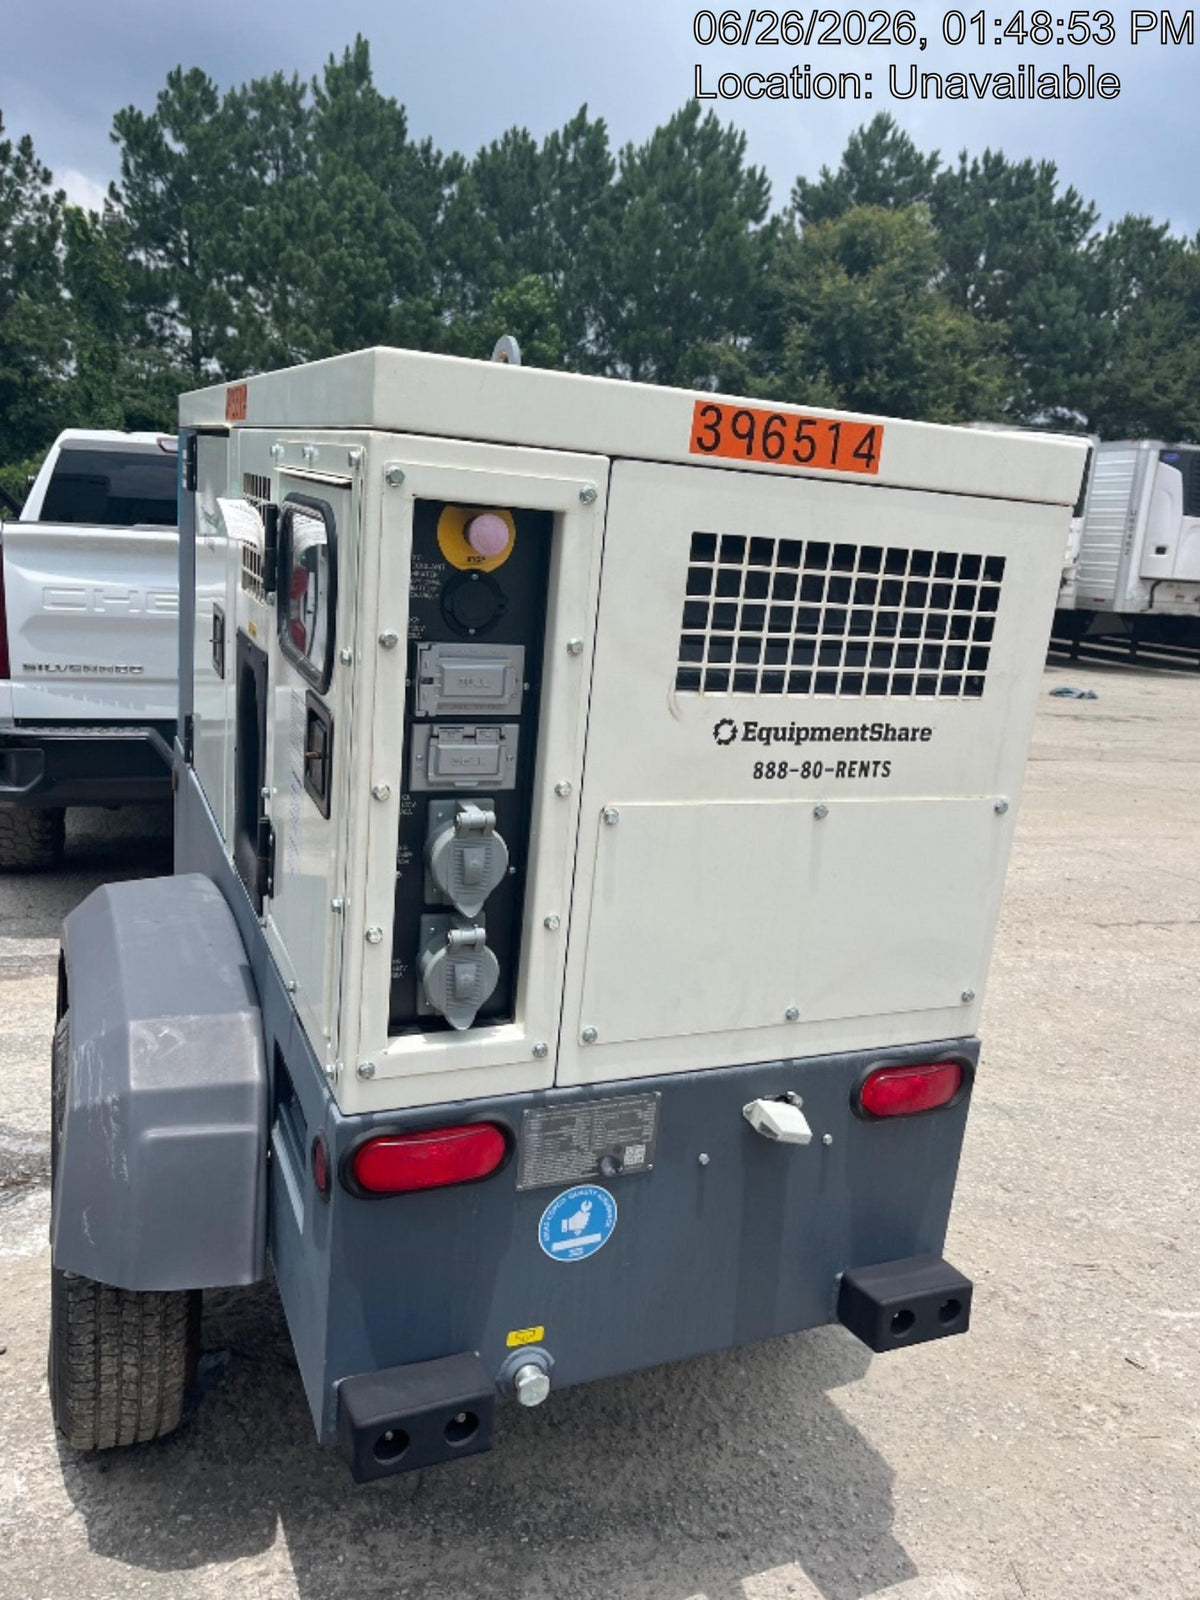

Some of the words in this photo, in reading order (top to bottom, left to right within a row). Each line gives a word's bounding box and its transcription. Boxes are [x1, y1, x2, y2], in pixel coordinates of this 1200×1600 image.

[696, 404, 876, 469] 396514
[741, 721, 933, 746] EquipmentShare
[753, 760, 892, 779] 888-80-RENTS
